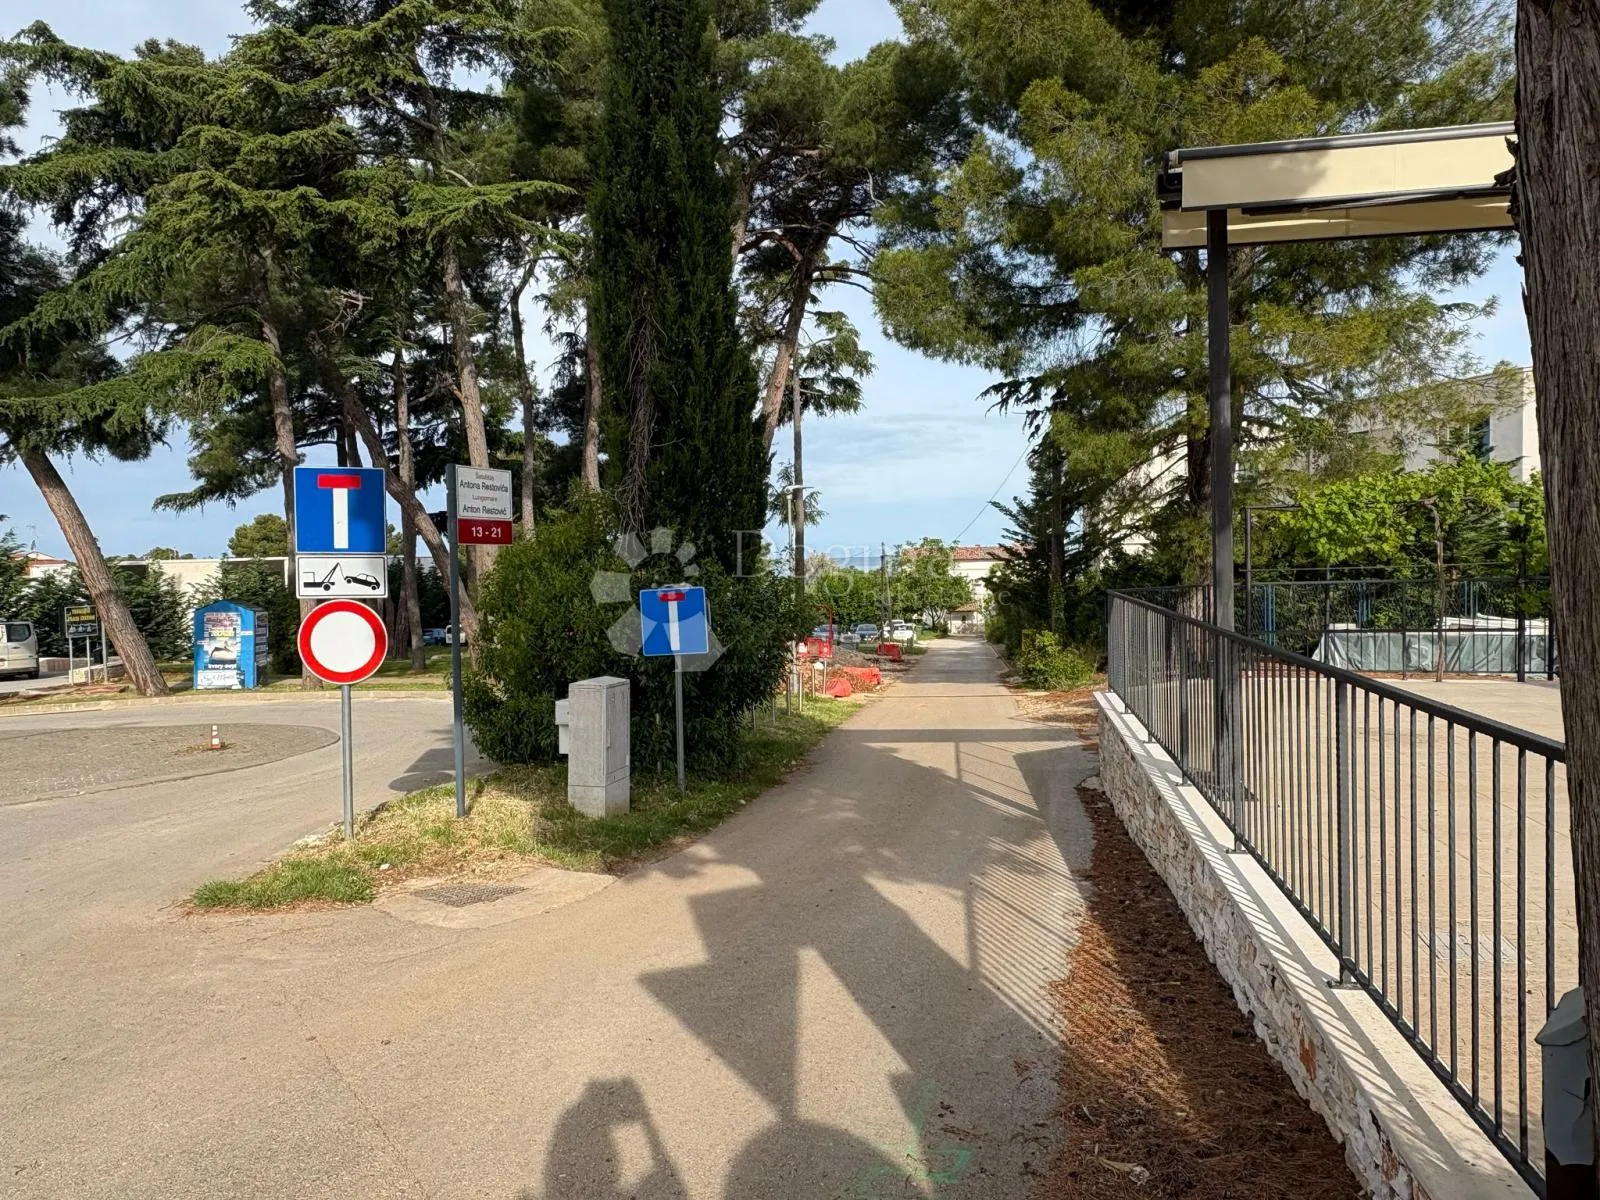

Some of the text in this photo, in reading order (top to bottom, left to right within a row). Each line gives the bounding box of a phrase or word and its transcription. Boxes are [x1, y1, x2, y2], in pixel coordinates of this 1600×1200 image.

[459, 480, 480, 489] Antona
[462, 504, 481, 514] Anton
[471, 526, 483, 537] 13
[491, 527, 501, 538] 21
